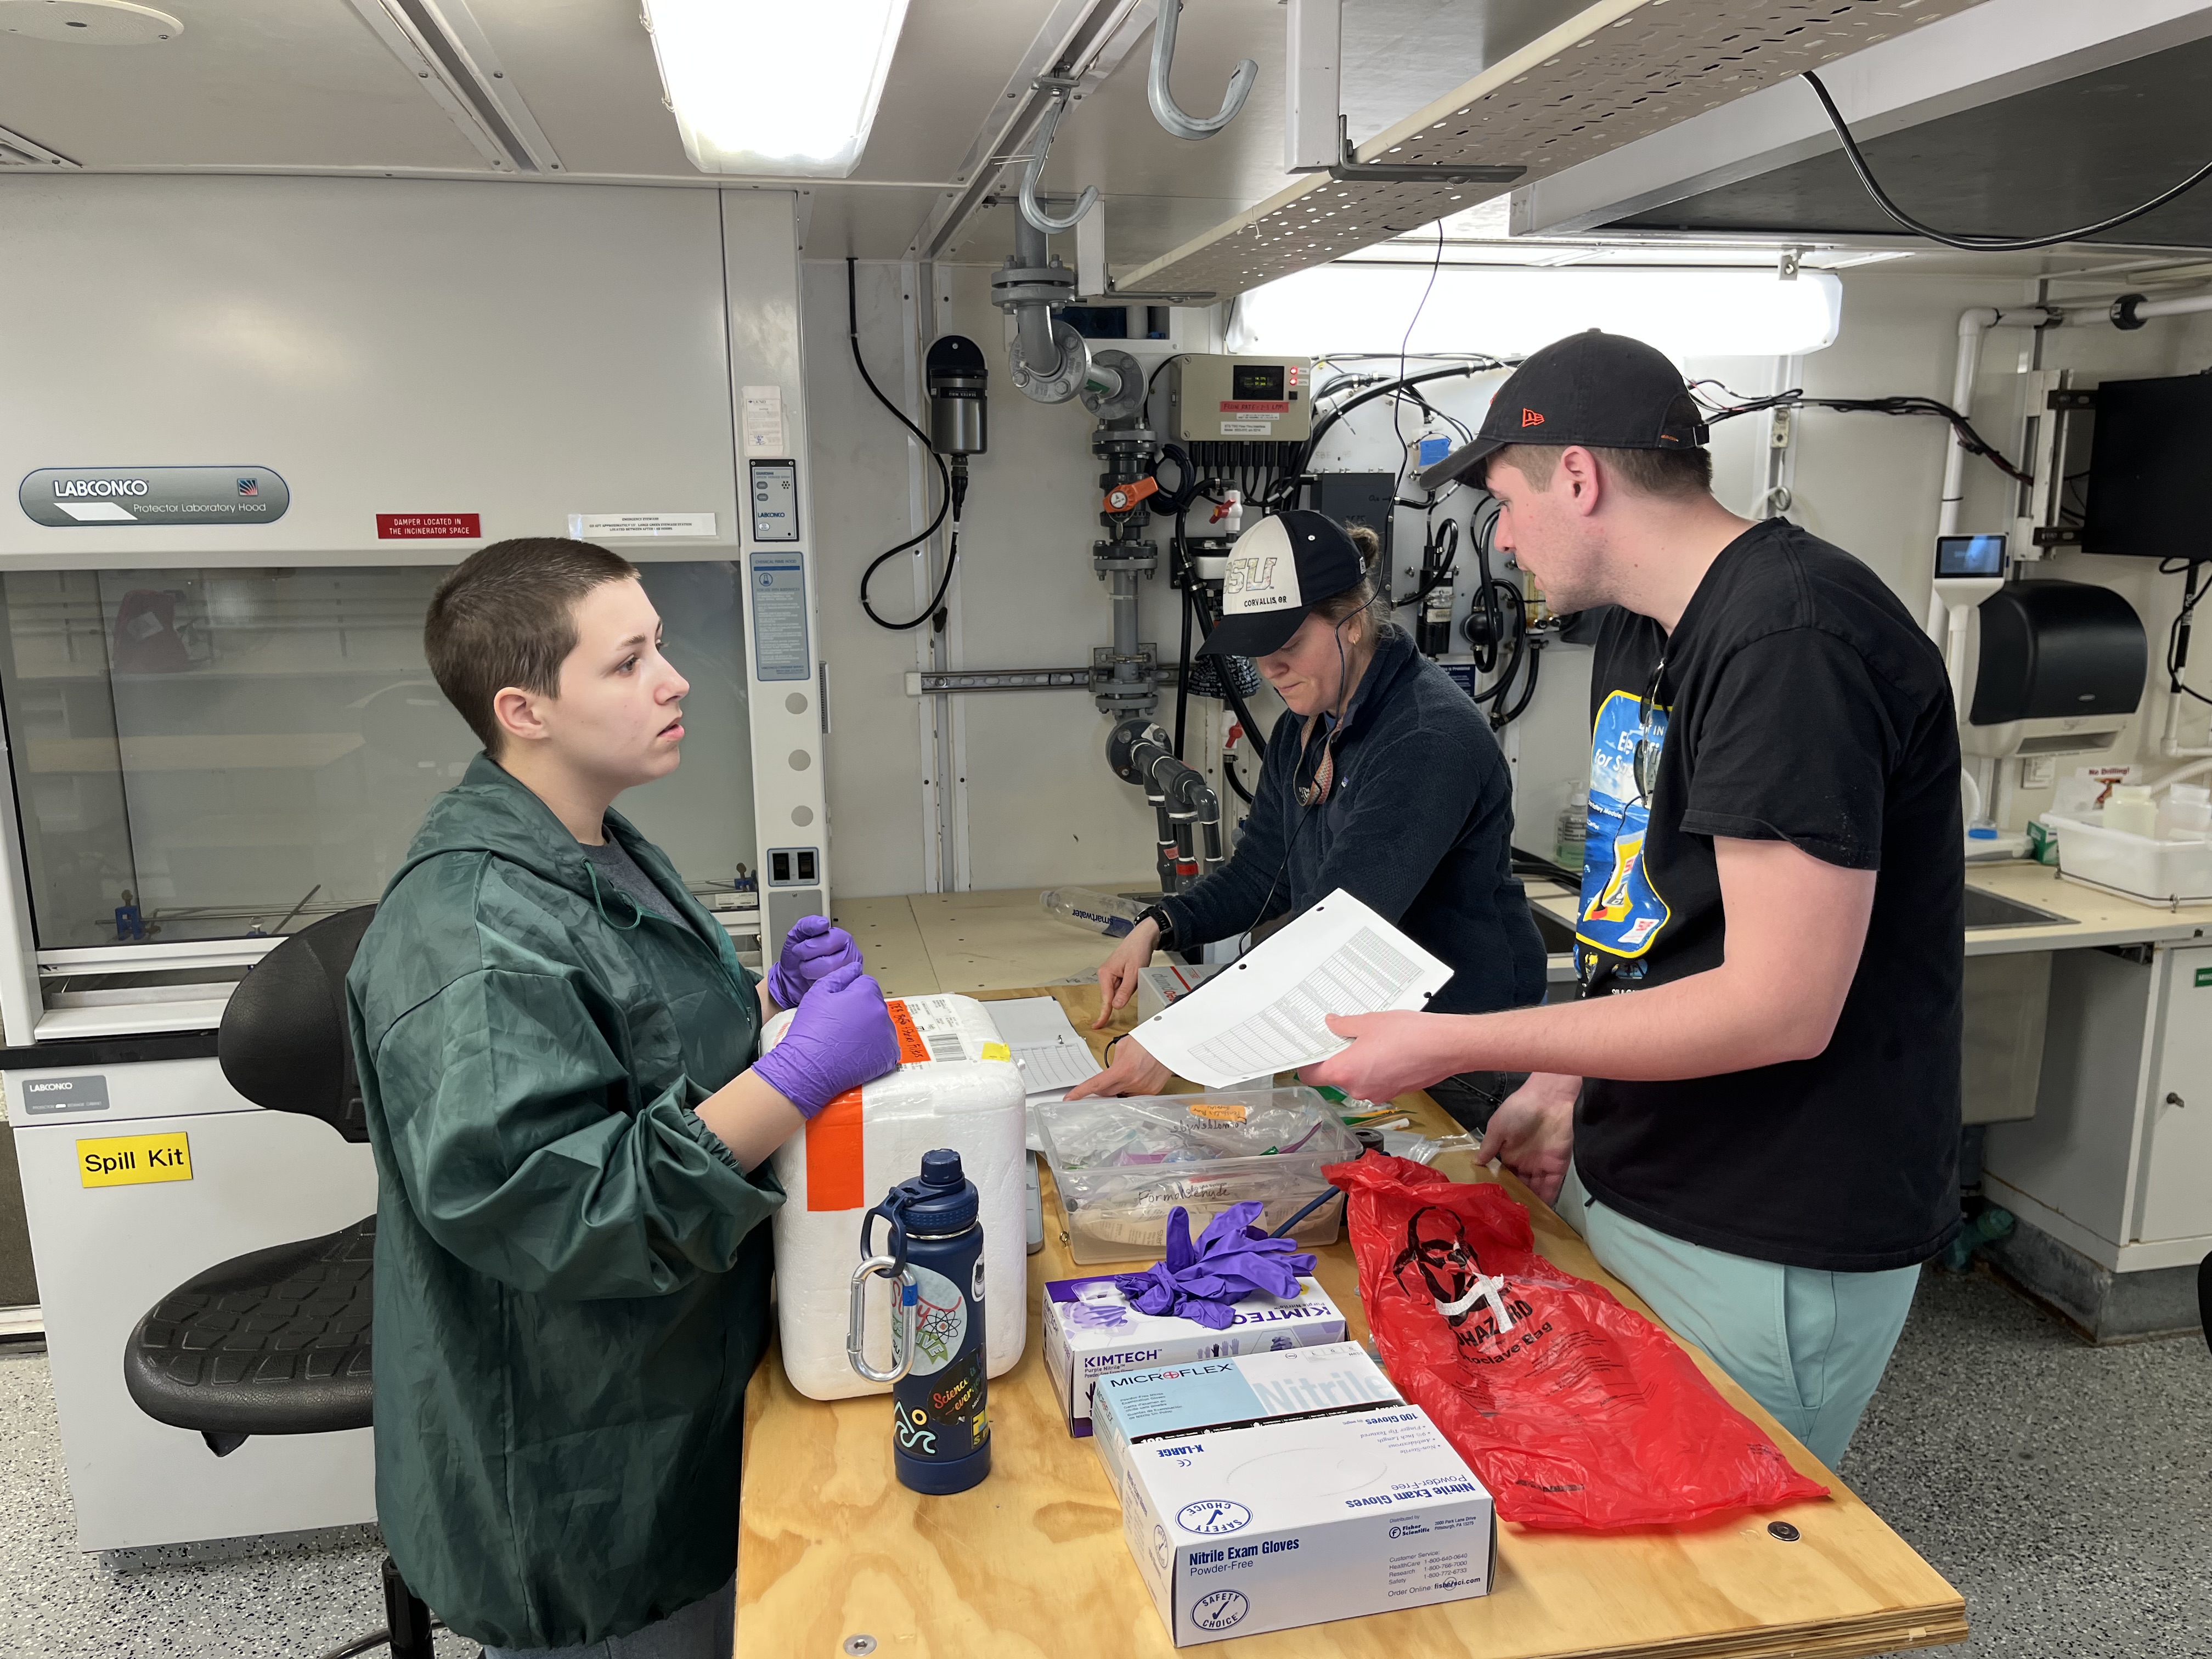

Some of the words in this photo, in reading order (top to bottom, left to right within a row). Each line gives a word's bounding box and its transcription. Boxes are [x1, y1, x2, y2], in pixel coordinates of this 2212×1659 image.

[54, 479, 148, 497] LABCONCO
[133, 503, 178, 513] Protector
[182, 503, 235, 513] Laboratory
[238, 503, 266, 512] Hood
[2102, 766, 2130, 776] Drilling!
[1072, 909, 1114, 925] smartwater
[1151, 974, 1178, 1002] eopump
[30, 1082, 72, 1092] LABCONCO
[85, 1152, 136, 1174] Spill
[149, 1148, 184, 1167] Kit
[1233, 1306, 1331, 1324] KIMTEC
[1457, 1300, 1533, 1347] HAZRD
[892, 1318, 945, 1357] OSIVE
[1462, 1344, 1521, 1364] toclave
[1522, 1322, 1553, 1345] Bag
[933, 1377, 969, 1409] Science
[1253, 1370, 1397, 1415] Nitrile
[1365, 1415, 1399, 1425] Gloves
[1400, 1413, 1418, 1421] 100
[1360, 1430, 1387, 1439] Textured
[1377, 1435, 1400, 1443] Length
[1388, 1438, 1431, 1448] Ambidextrous
[1400, 1444, 1437, 1454] Non-Sterile
[1156, 1444, 1205, 1457] X-LARGE
[1391, 1474, 1468, 1491] Powder-Free
[1432, 1482, 1476, 1495] Nitrile
[1345, 1494, 1393, 1508] Gloves
[1393, 1488, 1433, 1501] Exam
[1186, 1502, 1231, 1515] CHOICE
[1194, 1519, 1243, 1532] SAFETY
[1389, 1515, 1413, 1523] Distributed
[1402, 1527, 1430, 1536] Scientific
[1189, 1549, 1224, 1566] Nitrile
[1228, 1545, 1258, 1560] Exam
[1262, 1538, 1300, 1554] Gloves
[1389, 1554, 1417, 1563] Customer
[1418, 1550, 1440, 1559] Service:
[1389, 1561, 1421, 1570] HealthCare
[1424, 1553, 1468, 1564] 1-800-640-0640
[1190, 1560, 1254, 1577] Powder-Free
[1389, 1568, 1415, 1577] Research
[1424, 1560, 1468, 1571] 1-800-766-7000
[1424, 1567, 1467, 1579] 1-800-772-6733
[1387, 1589, 1408, 1597] Order
[1409, 1585, 1433, 1594] Online:
[1434, 1577, 1481, 1589] fishersci.com
[1202, 1593, 1240, 1606] SAFETY
[1202, 1614, 1238, 1628] CHOICE
